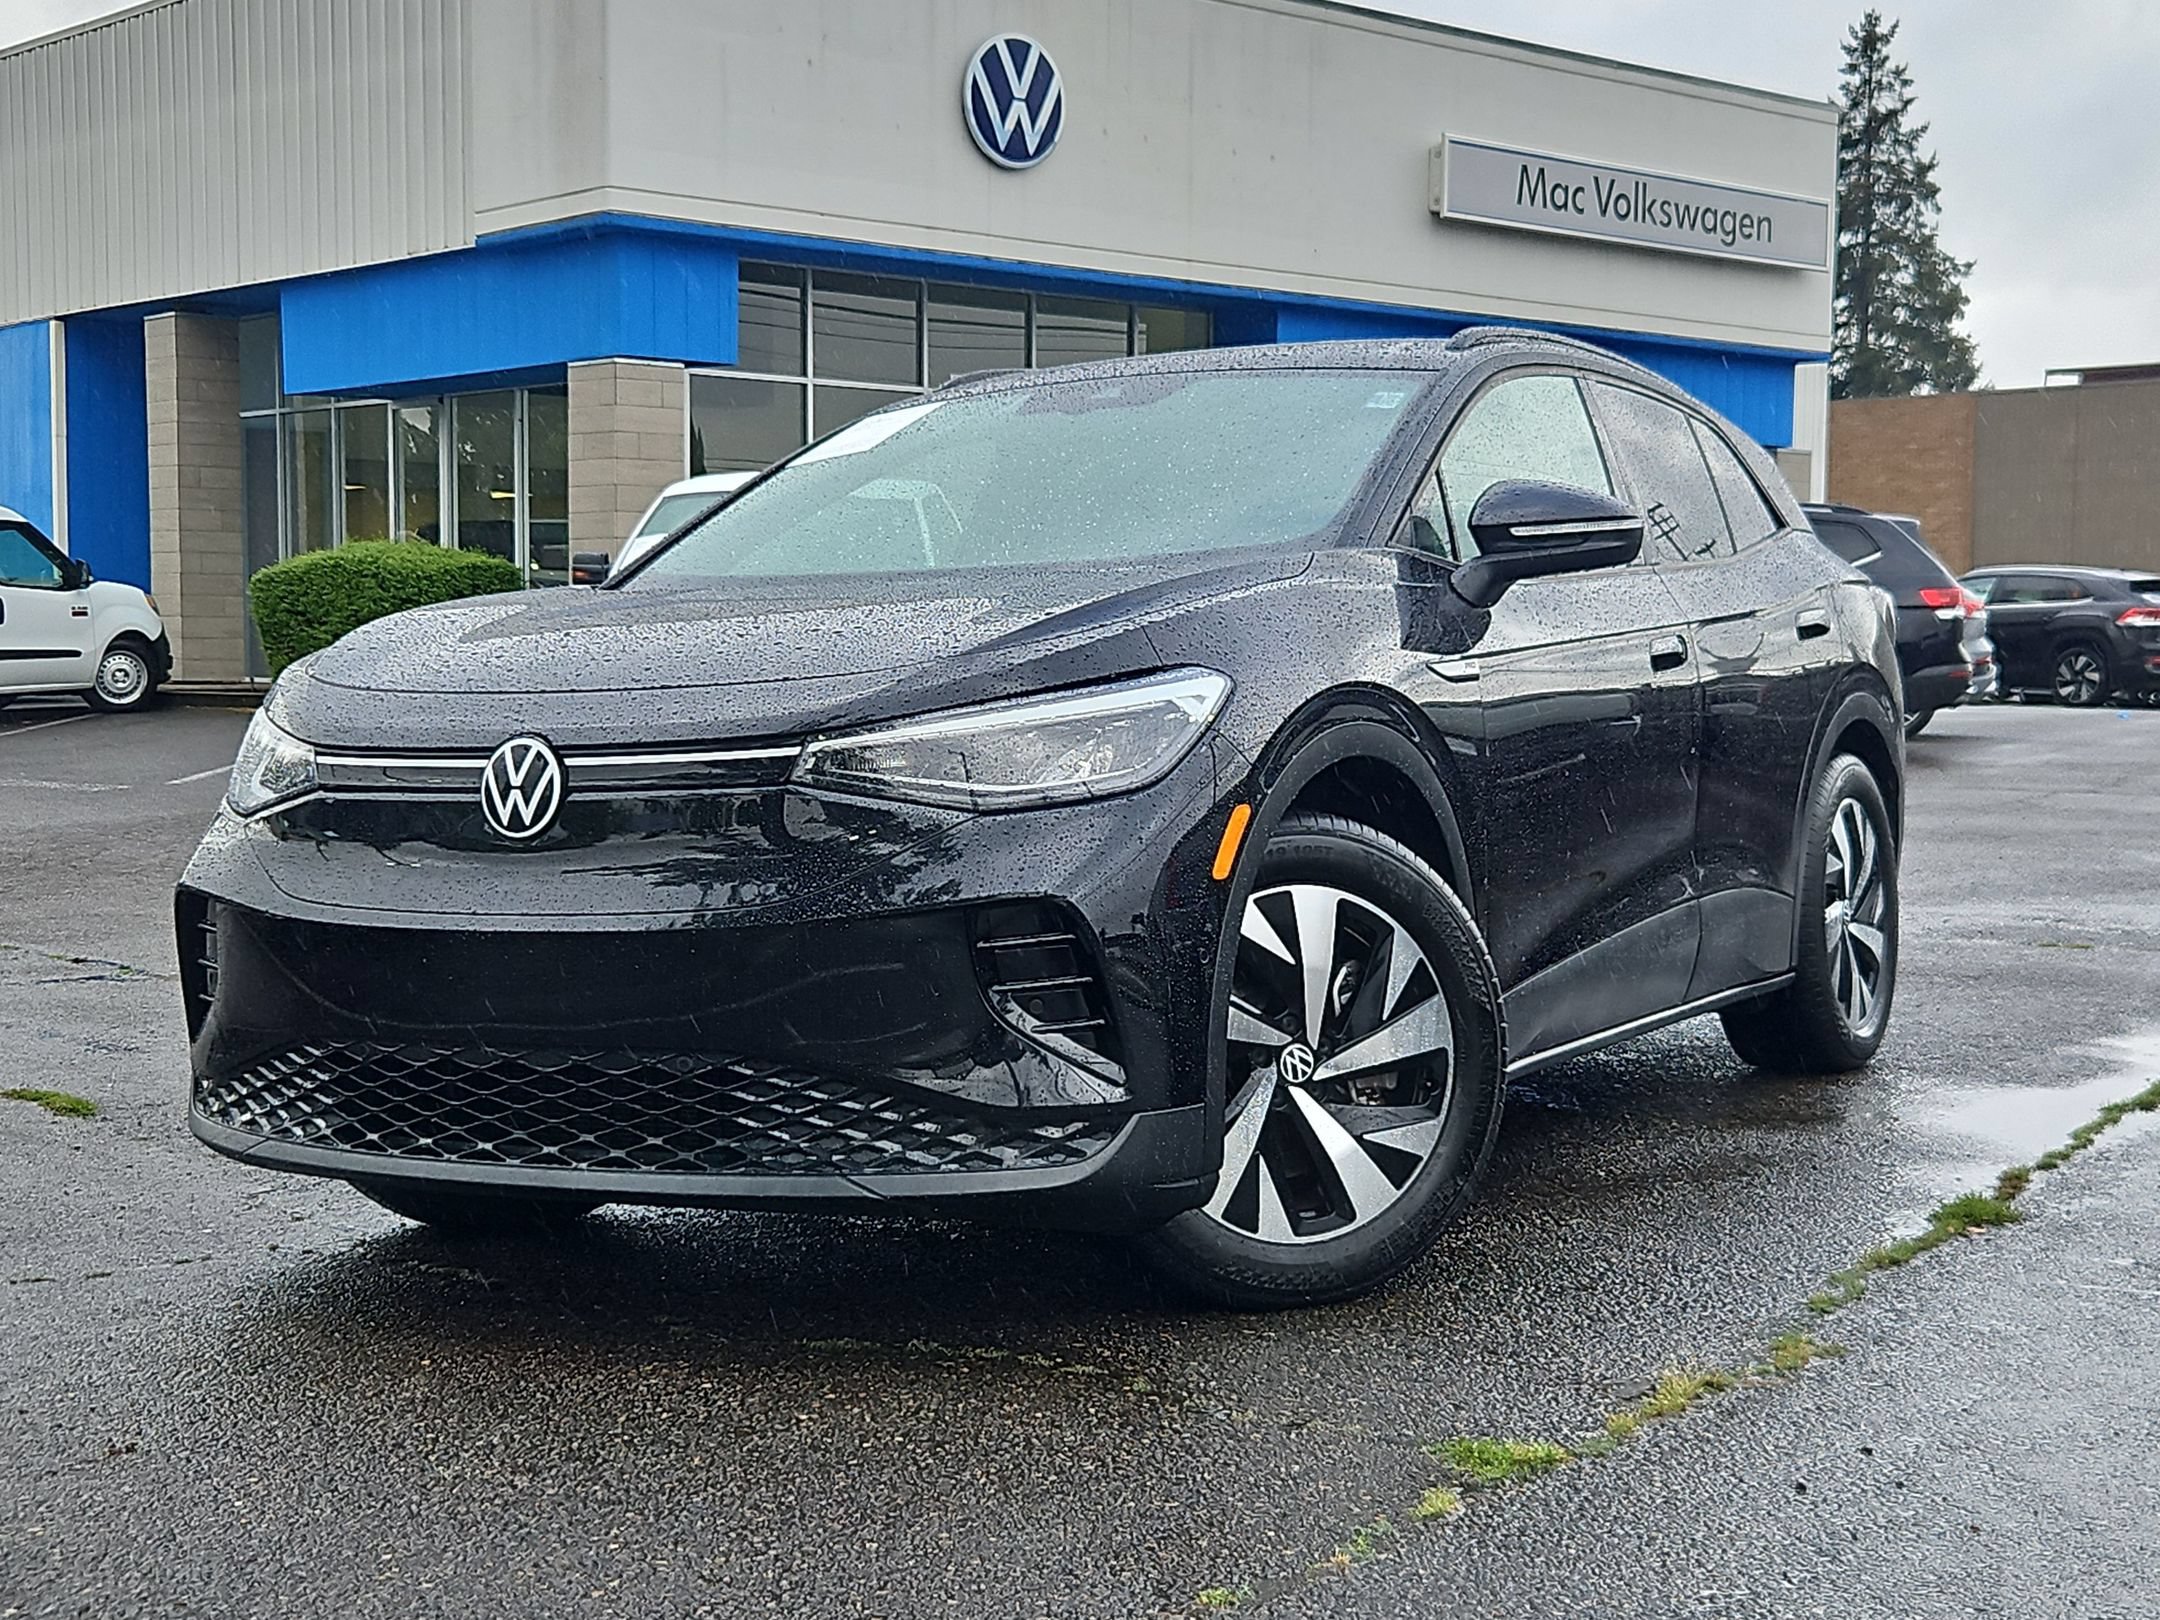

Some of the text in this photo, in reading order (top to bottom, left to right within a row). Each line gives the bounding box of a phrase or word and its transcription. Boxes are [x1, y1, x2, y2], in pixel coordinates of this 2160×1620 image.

[970, 36, 1062, 160] VW
[1516, 163, 1774, 248] Mac Volkswagen
[483, 740, 559, 832] VW
